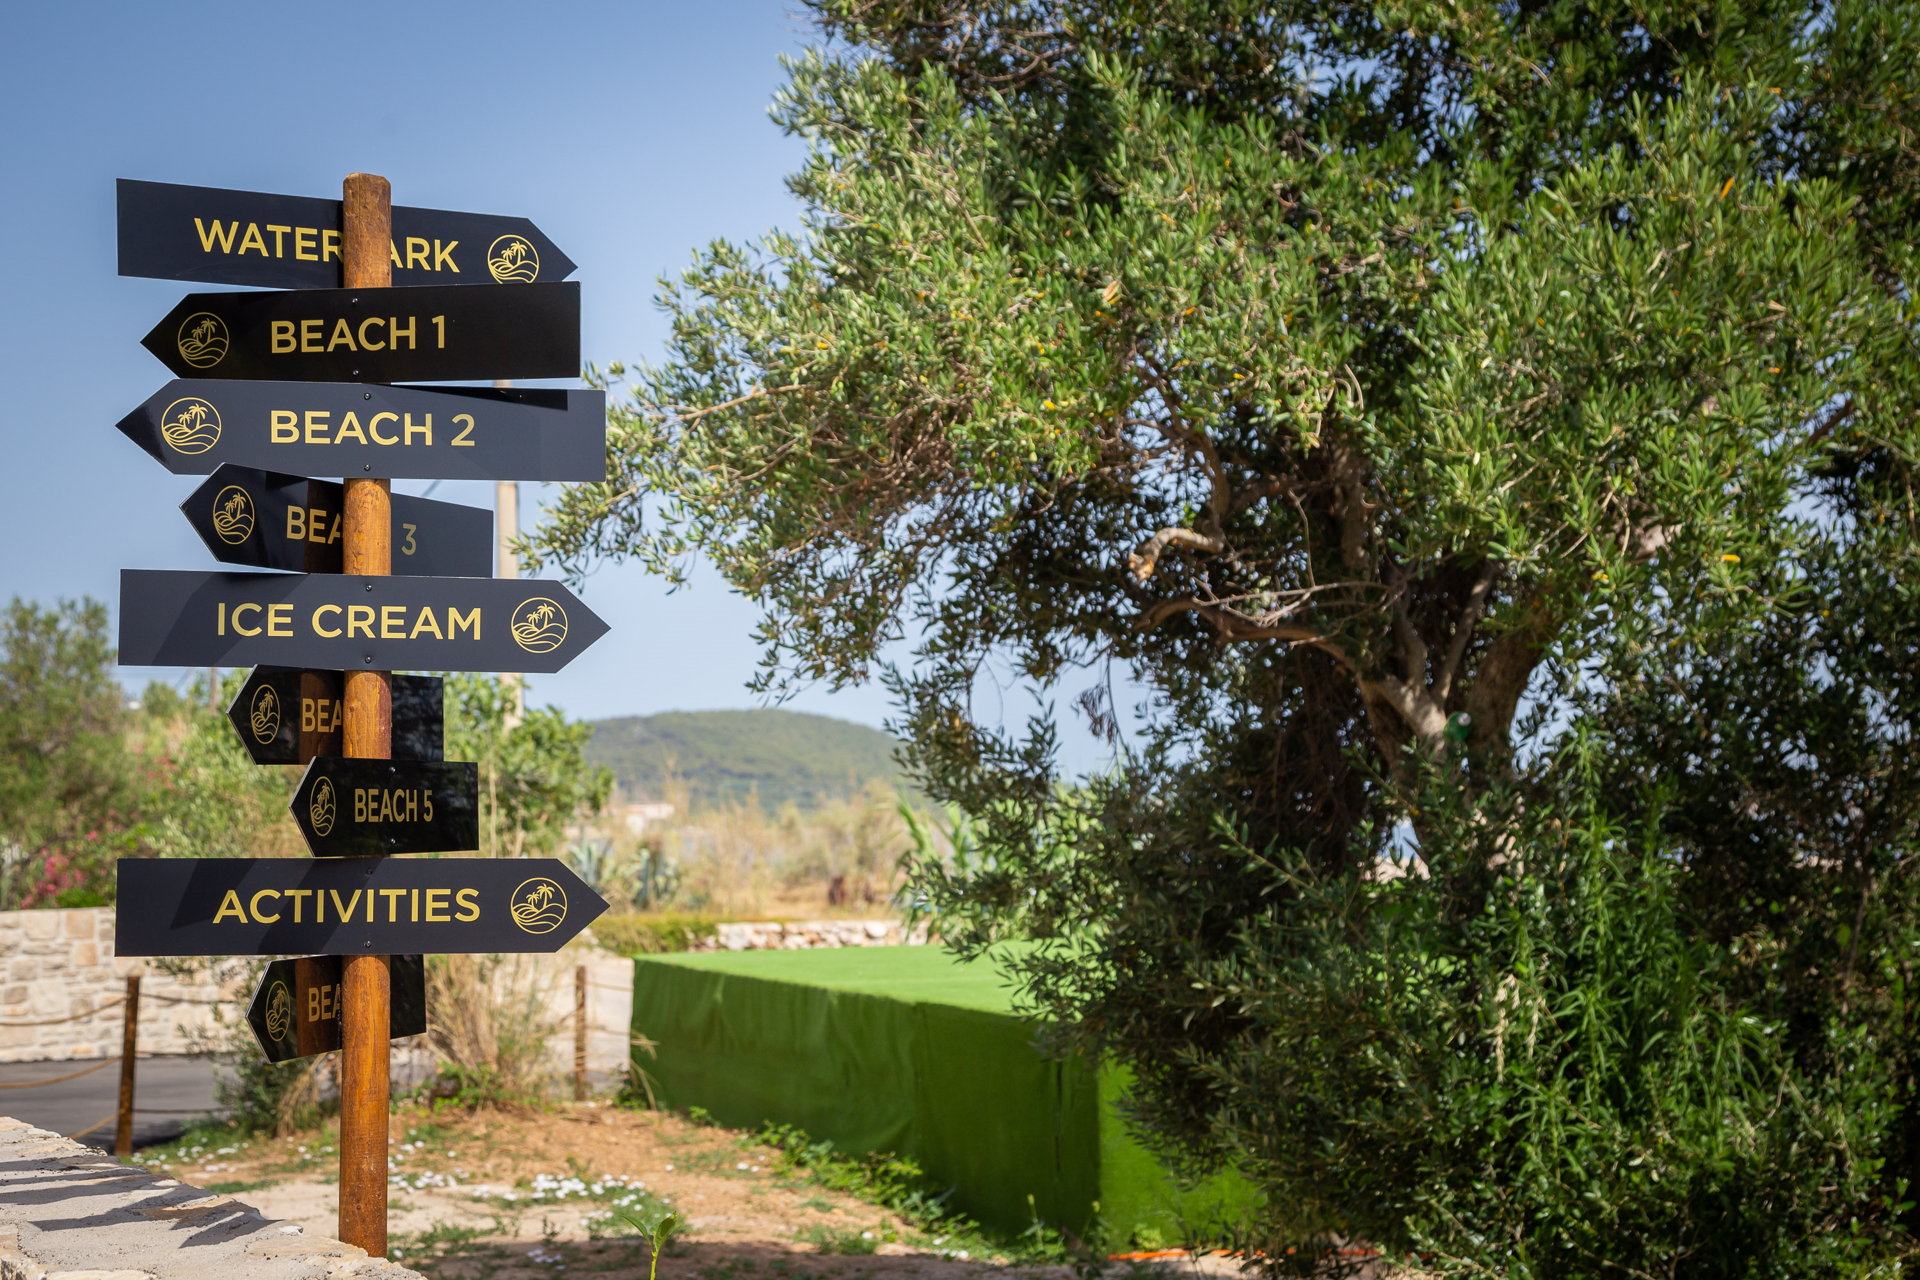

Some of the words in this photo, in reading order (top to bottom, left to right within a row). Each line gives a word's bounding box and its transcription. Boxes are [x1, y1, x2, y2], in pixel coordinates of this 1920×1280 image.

[270, 315, 416, 354] BEACH
[431, 315, 446, 349] 1
[270, 410, 433, 446] BEACH
[450, 413, 475, 447] 2
[286, 505, 342, 545] BEA
[401, 523, 417, 556] 3
[217, 602, 294, 638] ICE
[311, 604, 481, 641] CREAM
[302, 697, 342, 733] BEA
[354, 788, 418, 823] BEACH
[423, 789, 434, 822] 5
[212, 888, 481, 924] ACTIVITIES
[308, 983, 341, 1023] BEA
